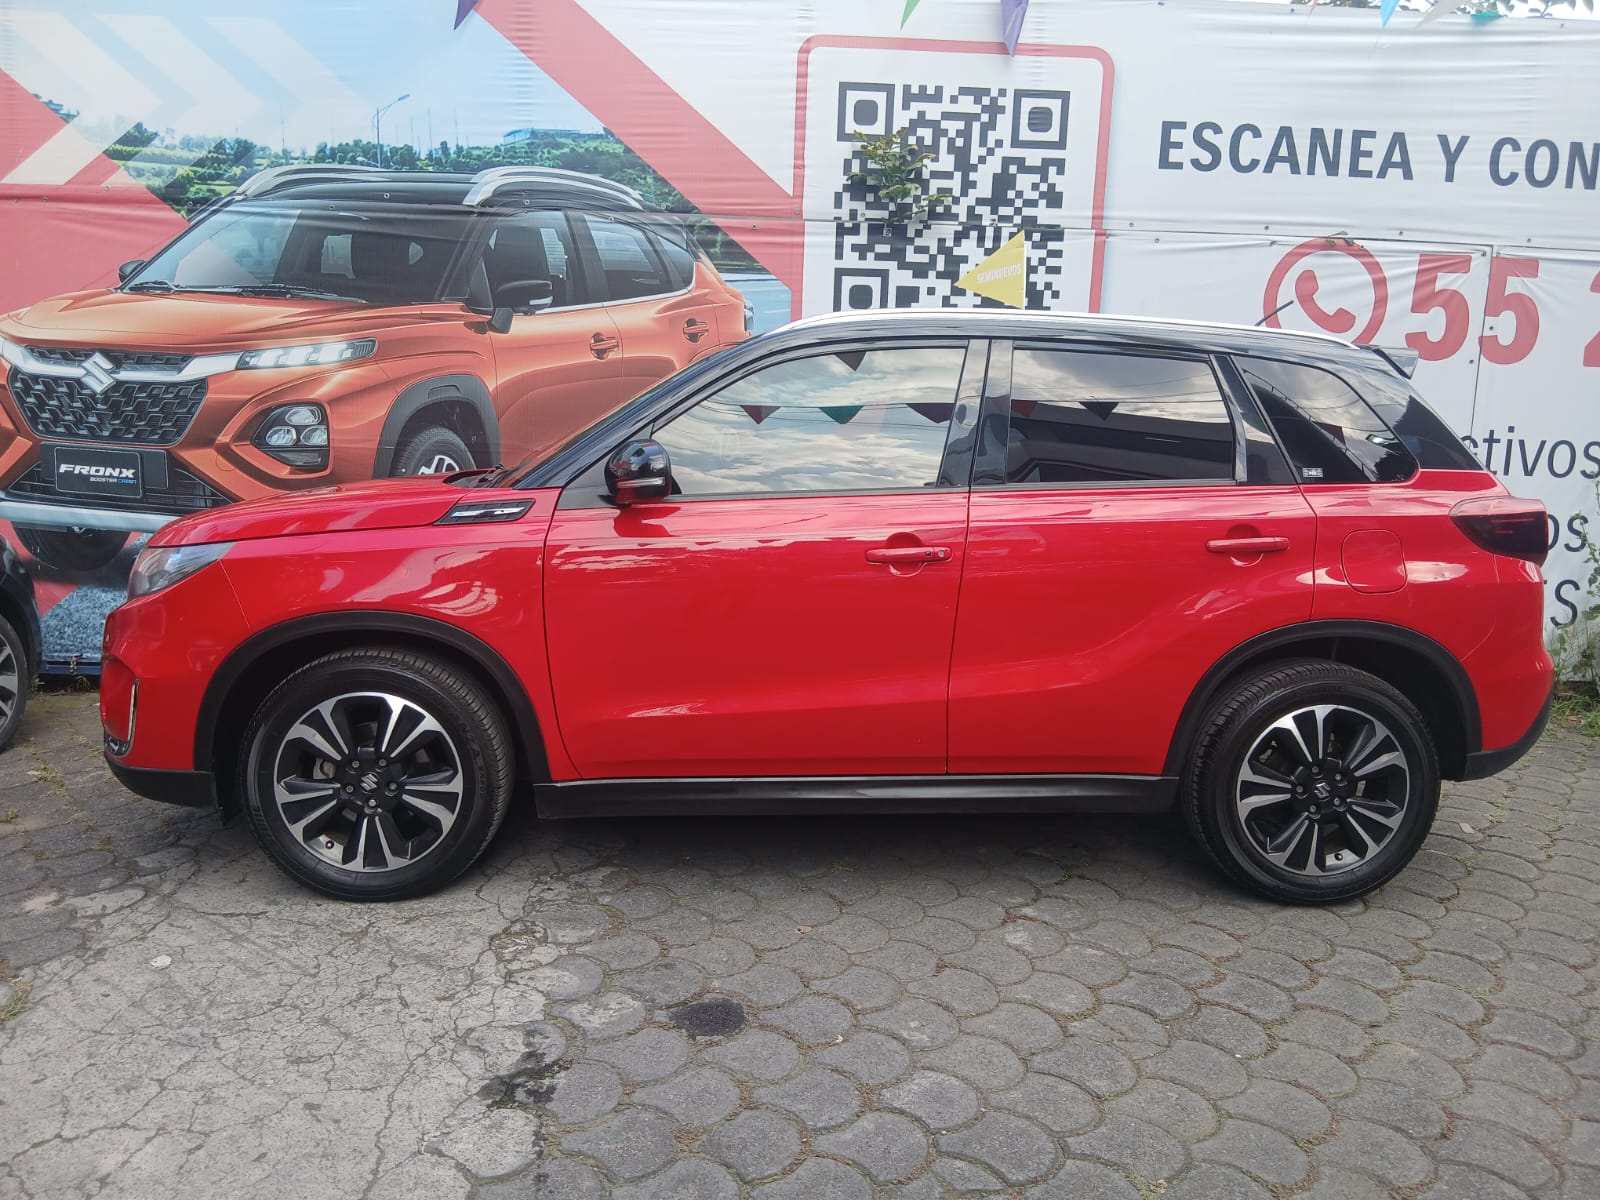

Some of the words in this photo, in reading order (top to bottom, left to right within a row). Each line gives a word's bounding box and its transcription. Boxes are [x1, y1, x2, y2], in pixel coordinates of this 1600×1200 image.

[1158, 120, 1414, 181] ESCANEA
[1437, 134, 1470, 183] Y
[1488, 136, 1600, 190] CON
[59, 463, 136, 478] FRONX
